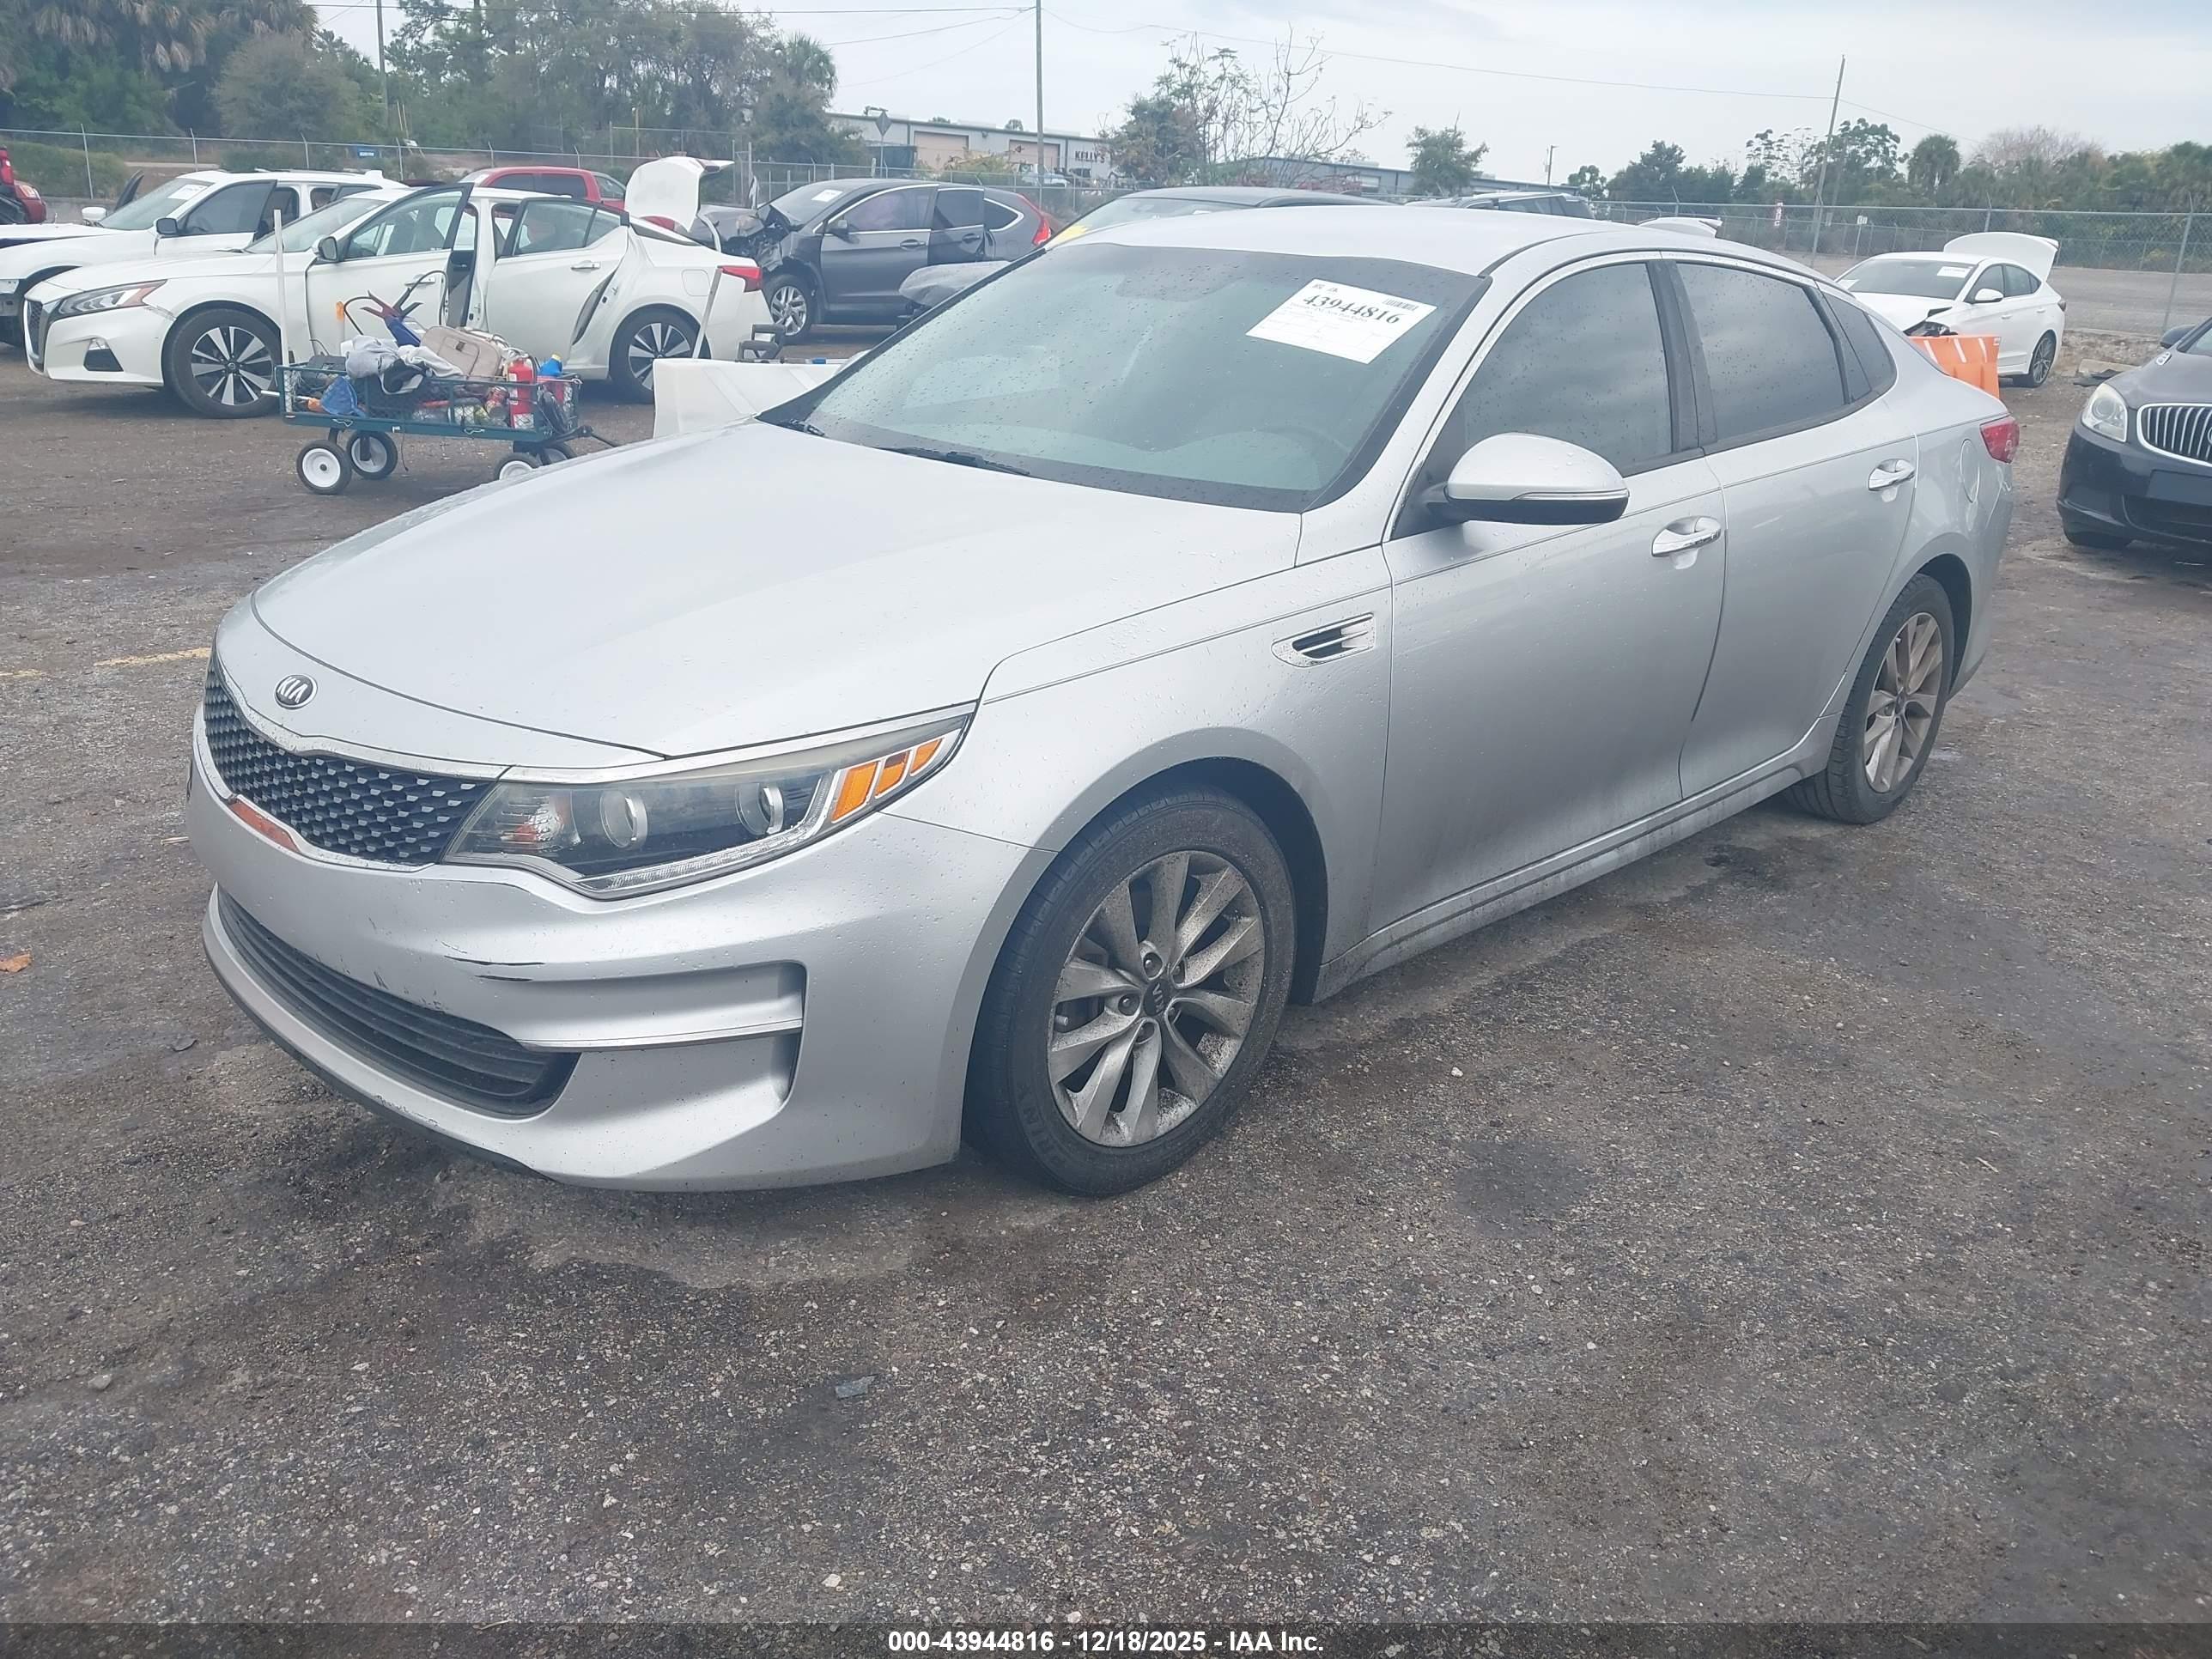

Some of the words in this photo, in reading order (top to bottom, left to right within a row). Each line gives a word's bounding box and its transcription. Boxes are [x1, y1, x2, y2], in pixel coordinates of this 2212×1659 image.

[1074, 150, 1105, 163] KELLY'S
[1303, 295, 1401, 324] 43944816
[276, 675, 309, 704] KIA
[1152, 981, 1164, 1013] KIA
